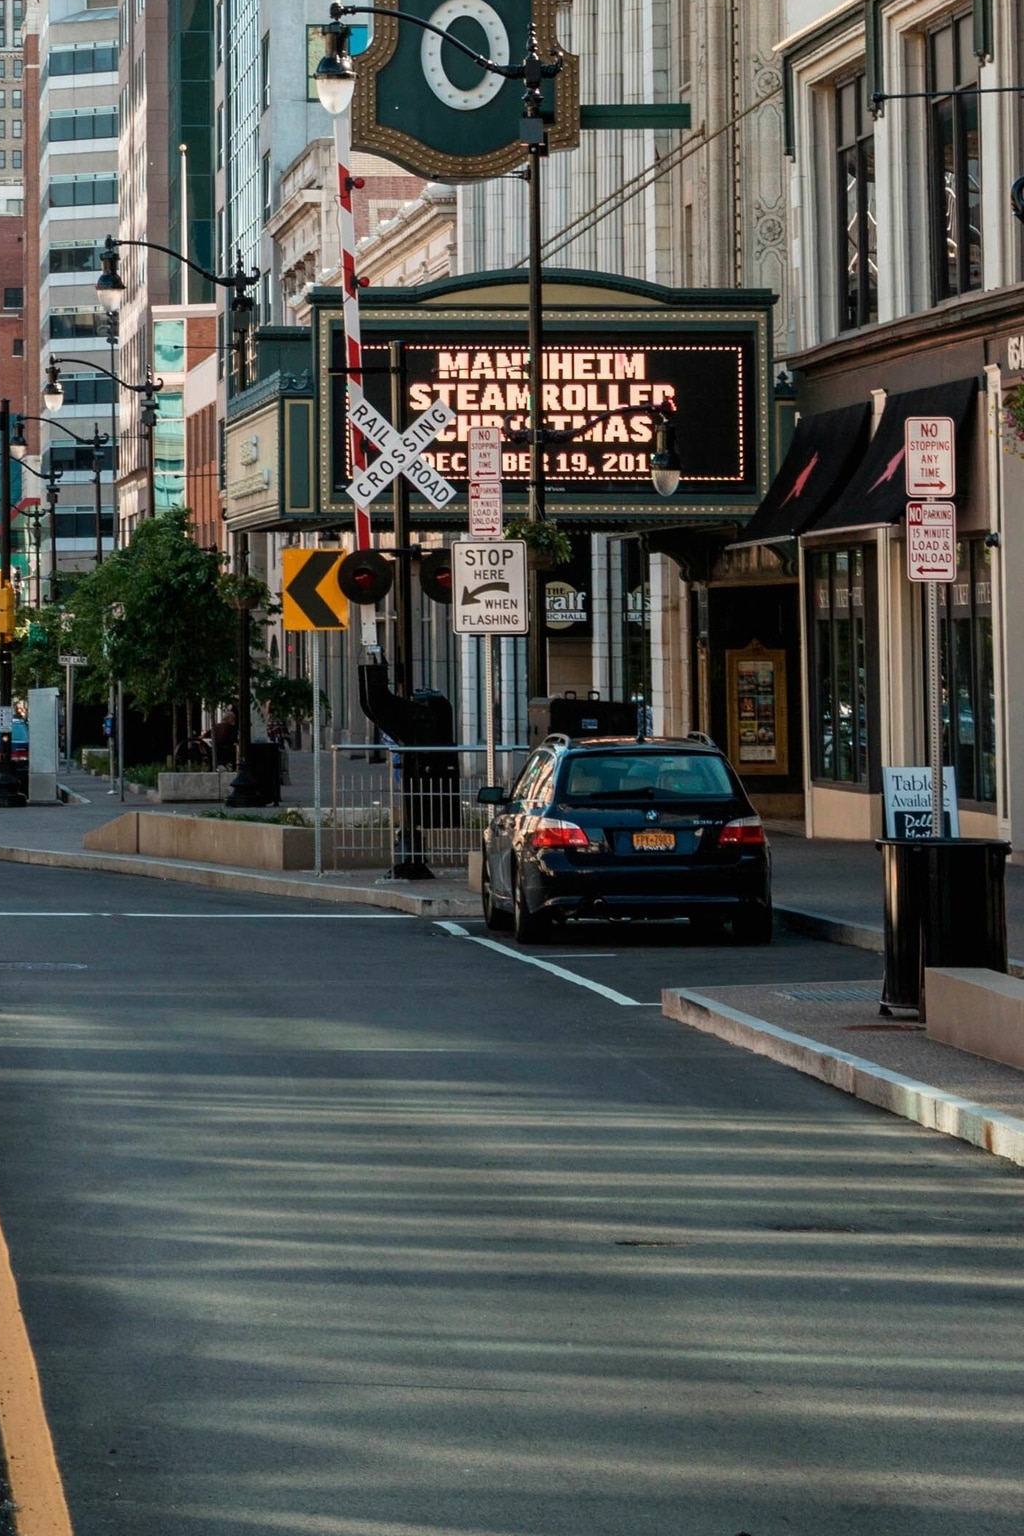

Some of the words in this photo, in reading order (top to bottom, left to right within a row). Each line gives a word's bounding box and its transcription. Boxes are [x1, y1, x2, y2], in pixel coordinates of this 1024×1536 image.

[478, 430, 491, 441] NO
[921, 423, 938, 438] NO
[910, 440, 950, 451] STOPPING
[352, 404, 390, 447] RAIL
[407, 460, 449, 503] ROAD
[357, 408, 446, 498] CROSSING
[556, 452, 596, 474] 19,
[921, 454, 939, 464] ANY
[478, 461, 492, 469] TIME
[920, 467, 940, 478] TIME
[909, 506, 922, 523] NO
[923, 509, 952, 520] PARKING
[472, 517, 499, 525] UNLOAD
[912, 528, 920, 538] 15
[923, 528, 950, 539] MINUTE
[912, 540, 939, 551] LOAD
[942, 541, 950, 551] &
[465, 549, 514, 566] STOP
[912, 552, 952, 563] UNLOAD
[474, 569, 505, 580] HERE
[485, 599, 518, 609] WHEN
[546, 592, 587, 610] ralf
[462, 615, 519, 625] FLASHING
